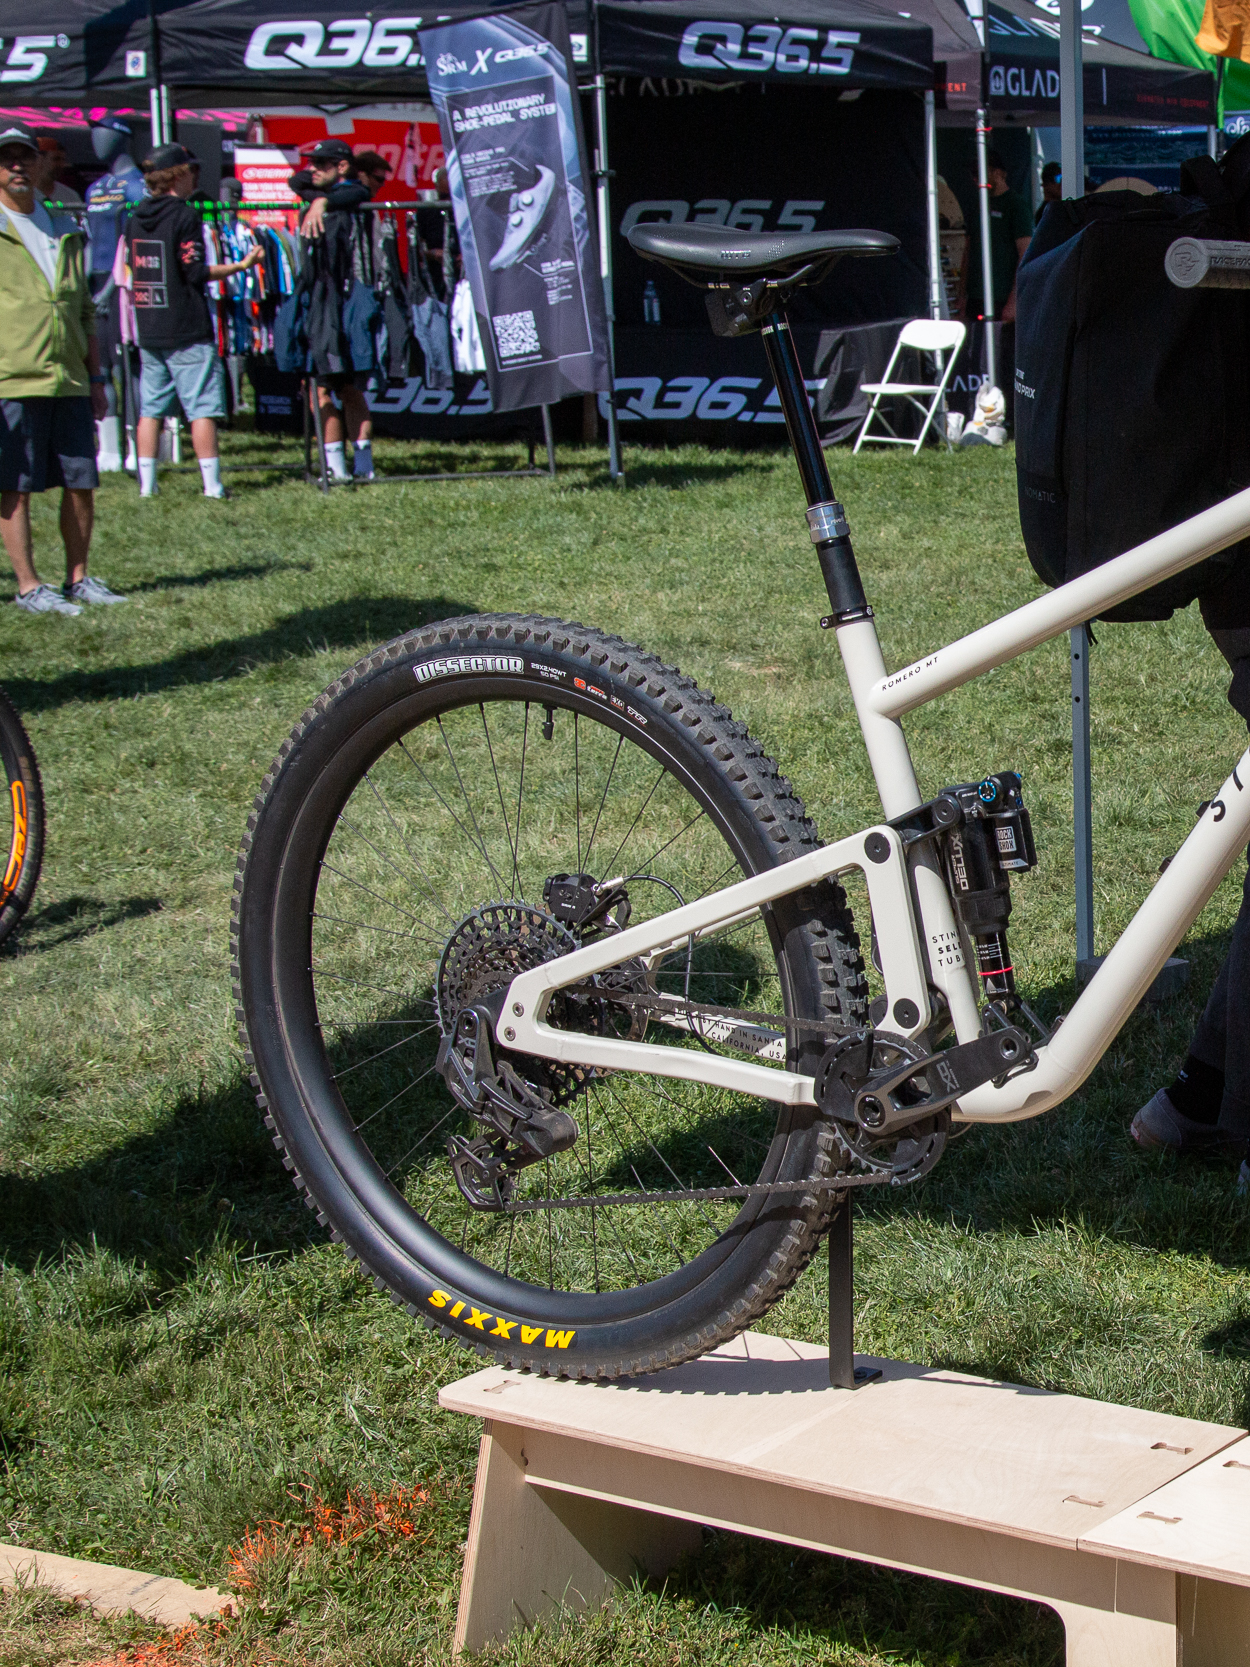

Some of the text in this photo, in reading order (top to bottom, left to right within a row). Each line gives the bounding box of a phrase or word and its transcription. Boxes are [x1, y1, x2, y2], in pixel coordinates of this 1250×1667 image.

[244, 17, 427, 69] Q36.
[678, 21, 861, 75] Q36.5
[436, 56, 468, 76] SRM
[469, 47, 493, 76] X
[1006, 67, 1061, 98] GLAD
[452, 93, 546, 122] A REVOLUTIONARY
[454, 103, 557, 133] SHOE-PEDAL SYSTEM
[413, 655, 524, 684] DISSECTOR
[881, 656, 939, 691] ROMERO MT
[711, 1031, 787, 1061] CALIFORNIA, USA
[715, 1021, 737, 1034] HAND
[739, 1030, 749, 1039] IN
[752, 1034, 783, 1048] SANTA
[427, 1289, 576, 1349] MAXXIS
